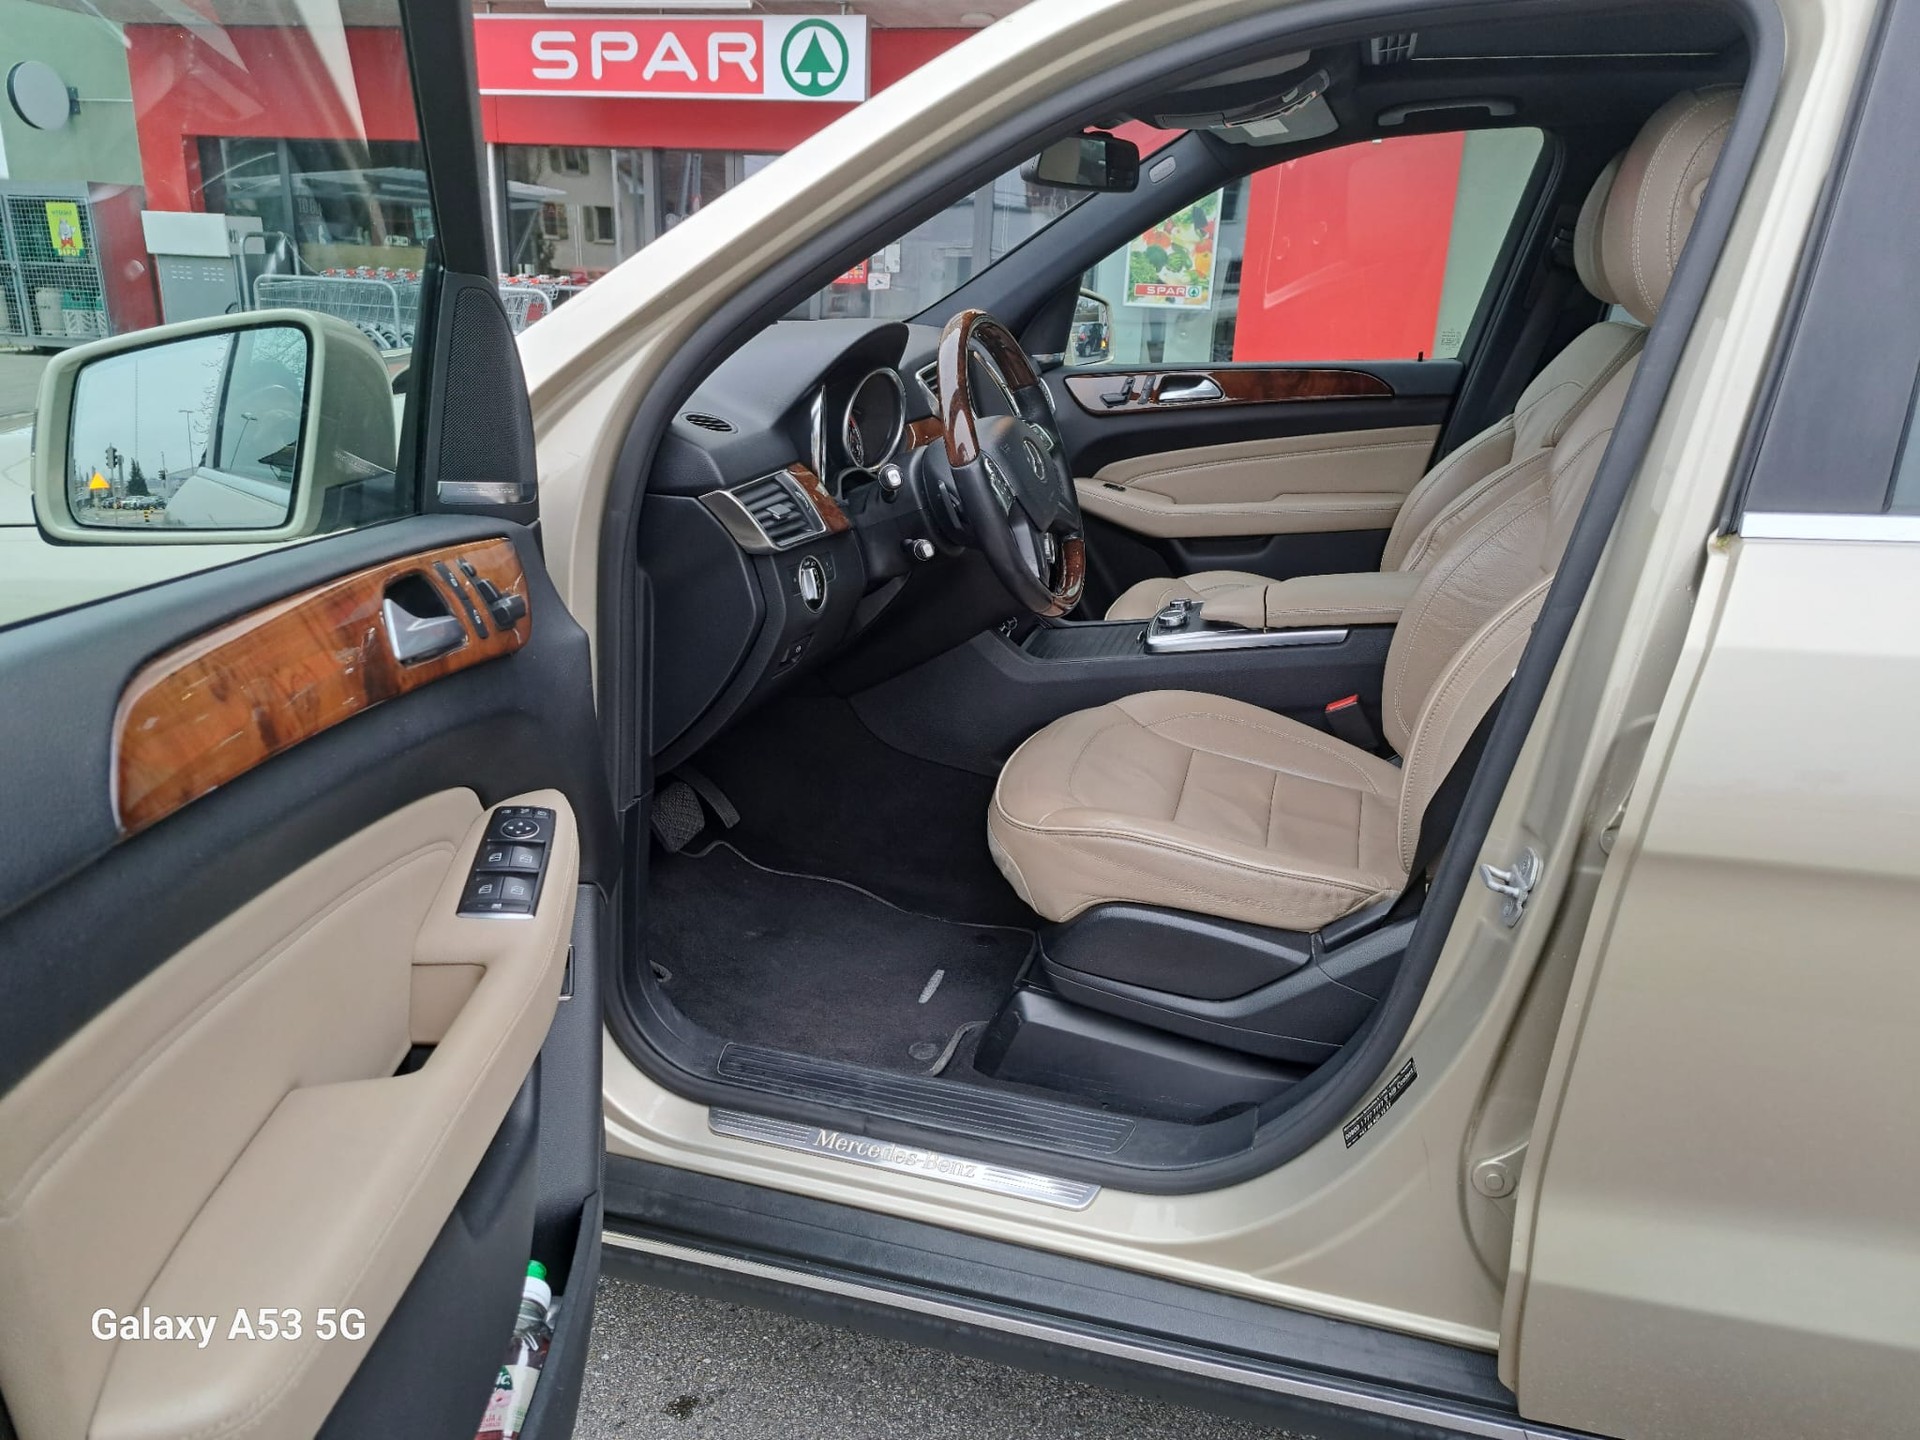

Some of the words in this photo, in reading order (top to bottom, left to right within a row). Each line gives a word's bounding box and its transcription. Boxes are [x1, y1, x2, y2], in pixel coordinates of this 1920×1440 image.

[531, 30, 758, 82] SPAR
[1146, 286, 1186, 295] SPAR
[812, 1128, 977, 1179] Mercedes-Benz
